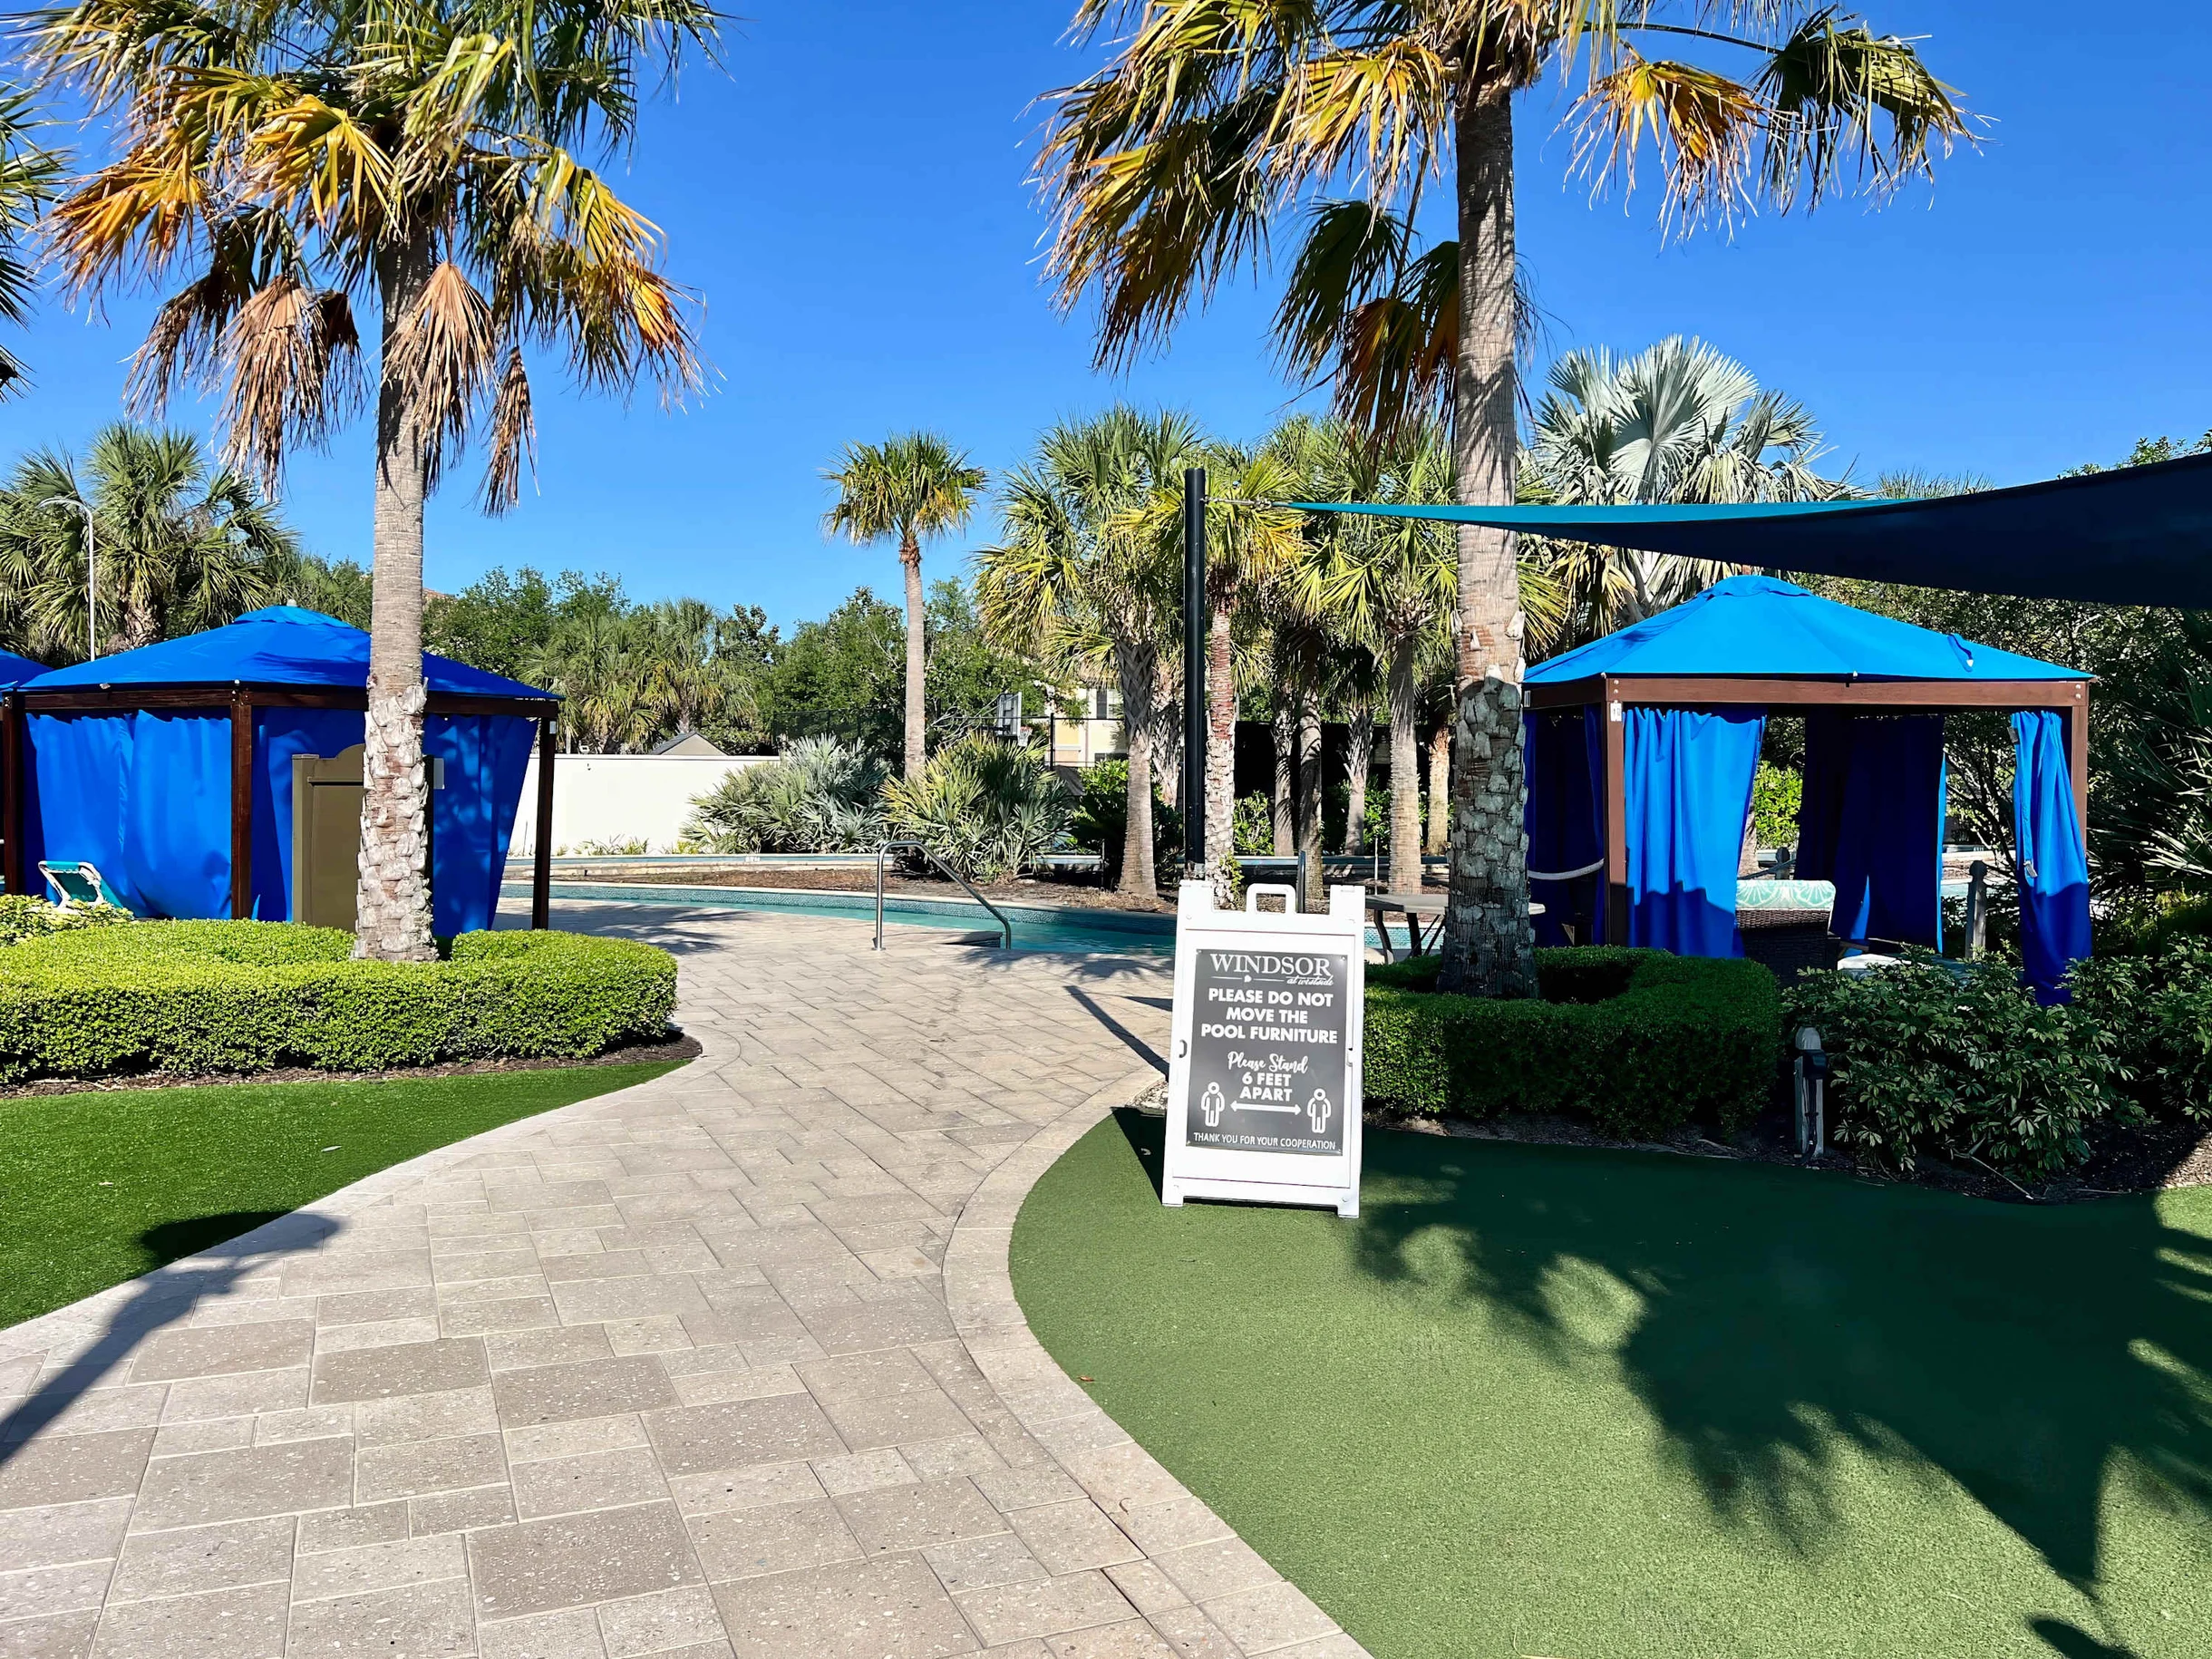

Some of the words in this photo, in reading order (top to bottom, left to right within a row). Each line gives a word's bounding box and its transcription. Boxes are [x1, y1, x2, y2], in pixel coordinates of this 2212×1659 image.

[1209, 953, 1333, 976] WINDSOR
[1285, 975, 1300, 985] at
[1208, 988, 1263, 1004] PLEASE
[1268, 991, 1293, 1005] DO
[1298, 993, 1334, 1007] NOT
[1226, 1007, 1275, 1023] MOVE
[1279, 1009, 1308, 1024] THE
[1201, 1024, 1246, 1039] POOL
[1250, 1026, 1338, 1044] FURNITURE
[1227, 1051, 1266, 1072] Please
[1268, 1053, 1309, 1073] Stand
[1242, 1072, 1253, 1085] 6
[1256, 1072, 1292, 1087] FEET
[1239, 1086, 1293, 1102] APART
[1193, 1131, 1220, 1143] THANK
[1221, 1133, 1238, 1144] YOU
[1239, 1135, 1256, 1145] FOR
[1256, 1137, 1278, 1147] YOUR
[1280, 1138, 1336, 1150] COOPERATION
